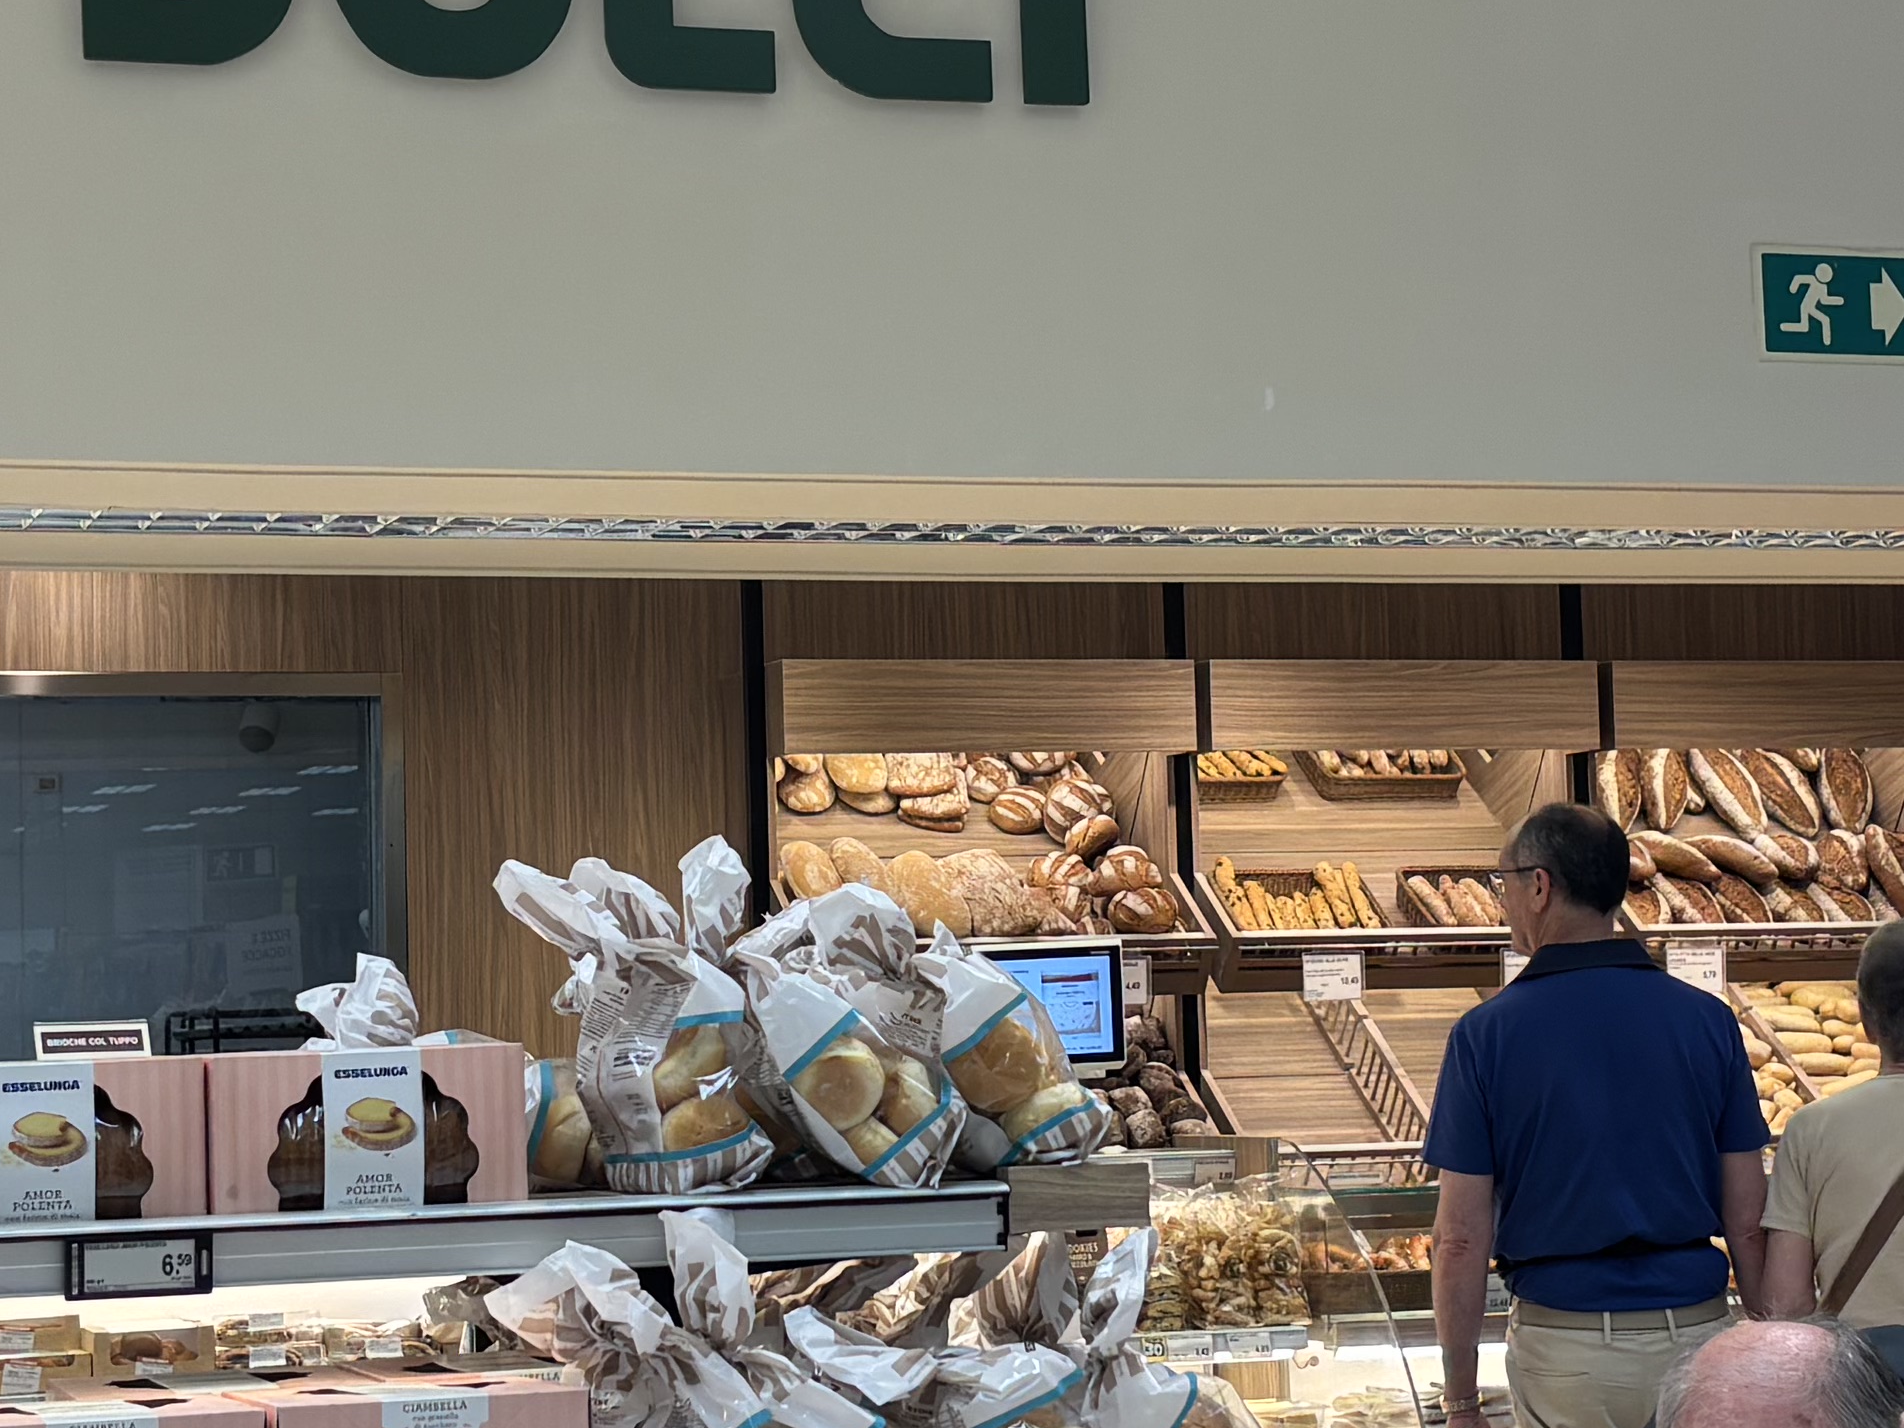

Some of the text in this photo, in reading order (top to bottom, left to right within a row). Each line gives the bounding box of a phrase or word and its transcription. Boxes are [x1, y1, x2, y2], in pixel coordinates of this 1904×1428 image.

[88, 1036, 107, 1046] COL
[355, 1174, 393, 1185] AMOR
[22, 1189, 62, 1201] AMOR
[345, 1183, 402, 1196] POLENTA
[12, 1199, 72, 1212] POLENTA
[402, 1399, 468, 1414] CIAMBELLA
